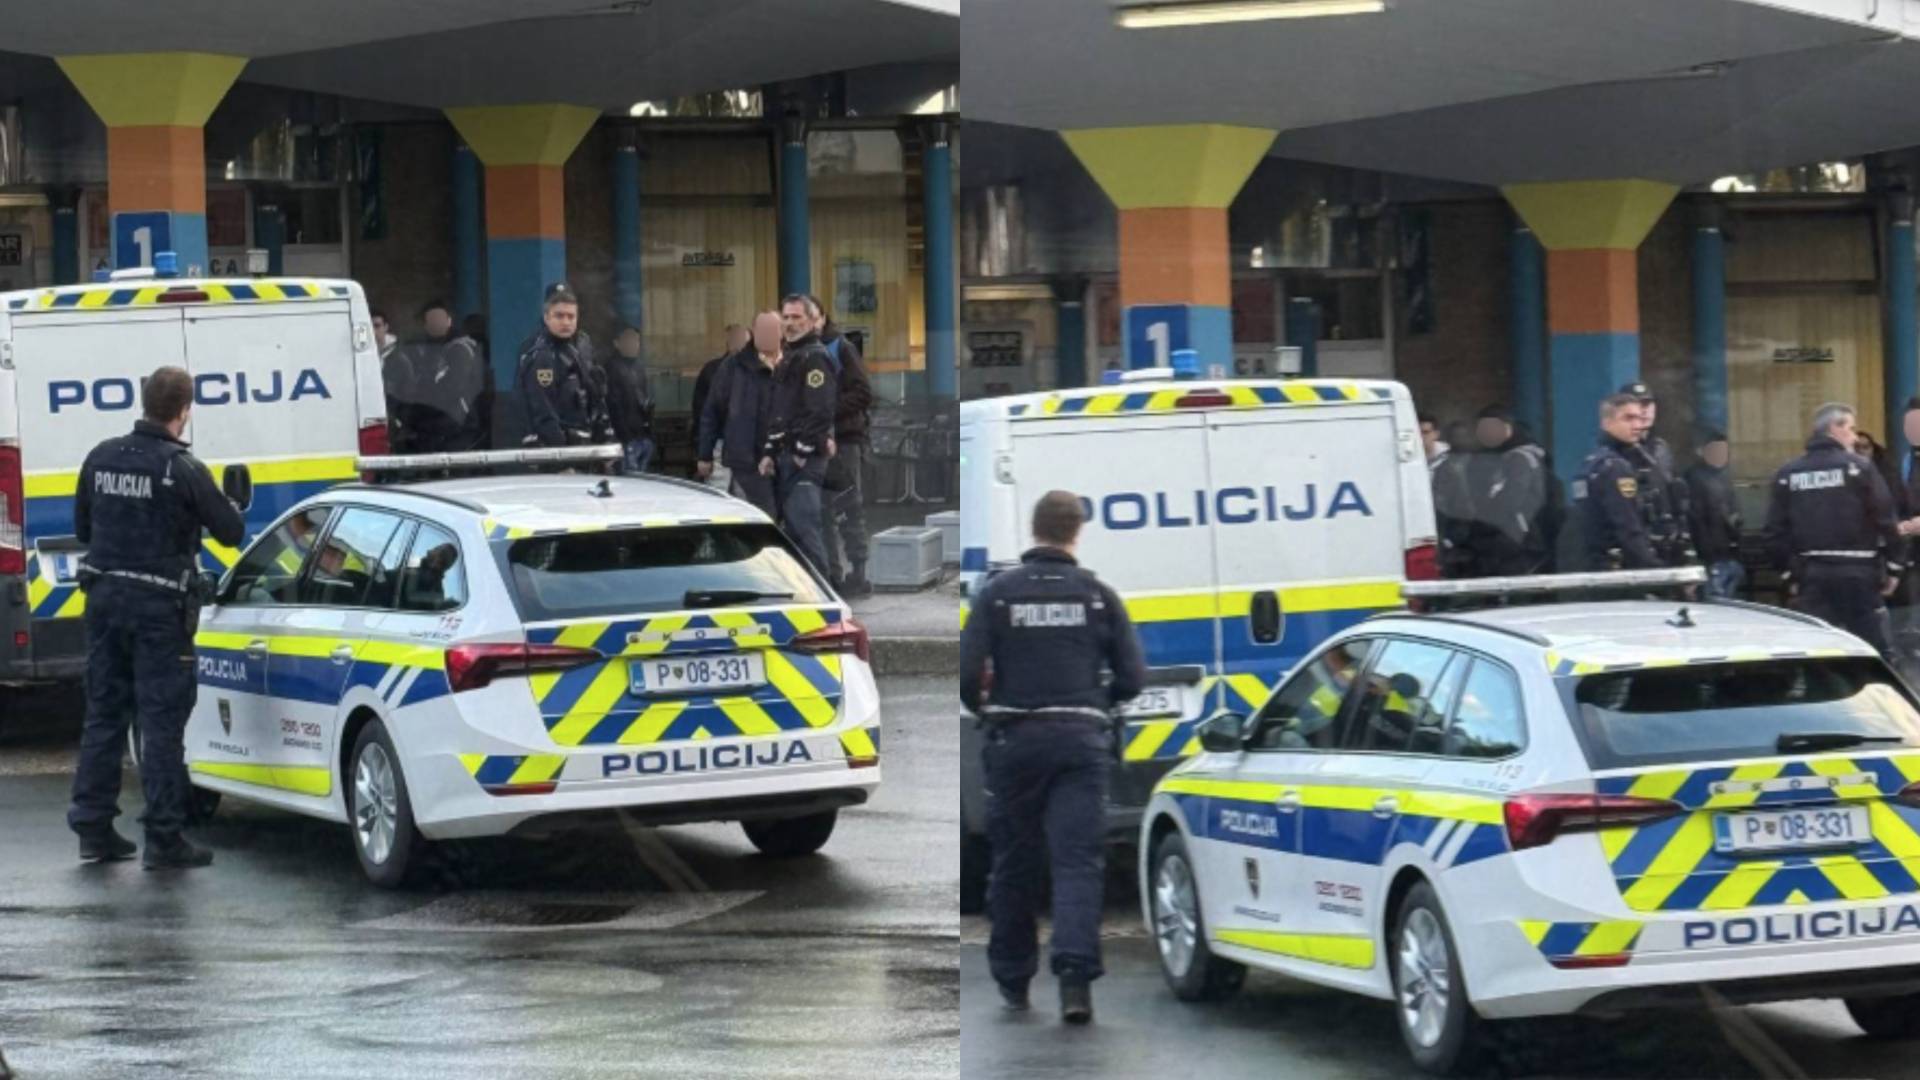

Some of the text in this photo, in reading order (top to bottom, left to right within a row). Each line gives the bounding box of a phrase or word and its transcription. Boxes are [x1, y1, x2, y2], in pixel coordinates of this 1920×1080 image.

[1146, 322, 1170, 368] 1
[48, 368, 332, 413] POCIJA
[94, 471, 152, 498] POLICIJA
[1010, 603, 1086, 627] POLICIJA
[198, 656, 247, 681] POLICIJA
[657, 658, 750, 685] P 08-331
[602, 740, 812, 777] POLICIJA
[1220, 809, 1279, 838] POLICIJA
[1746, 811, 1853, 843] P 08-331
[1684, 904, 1920, 948] POLICIJA
